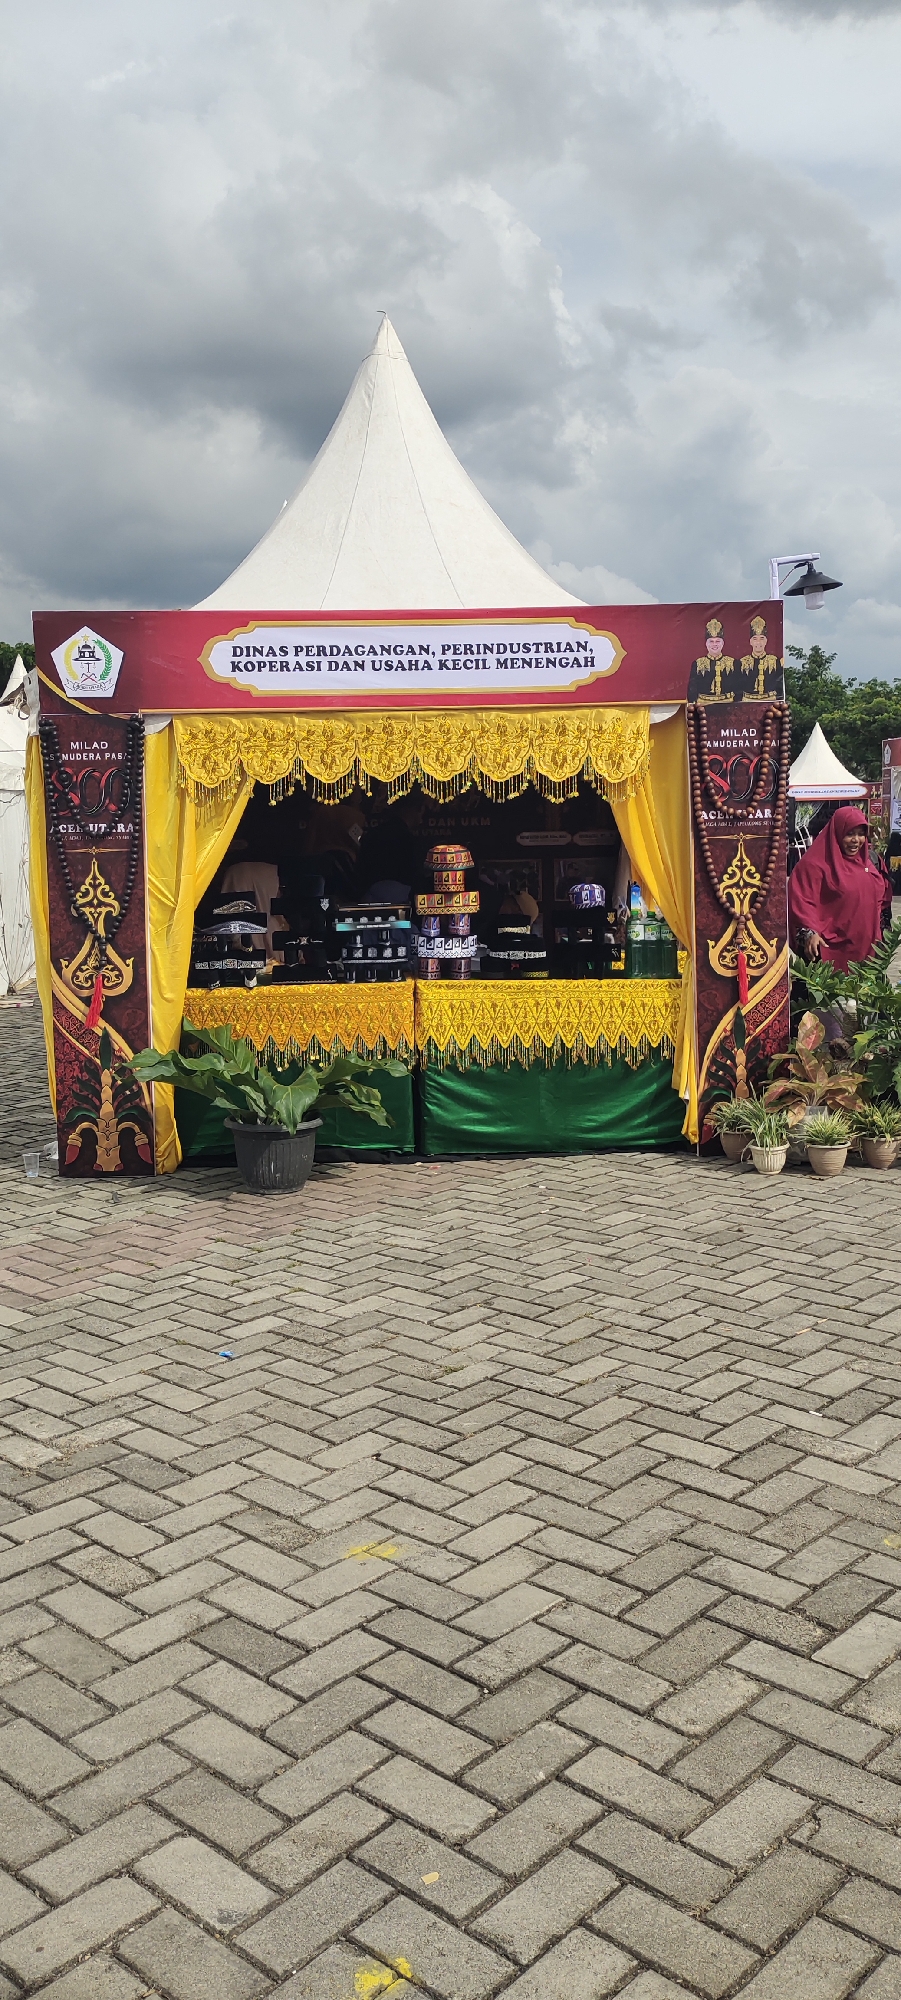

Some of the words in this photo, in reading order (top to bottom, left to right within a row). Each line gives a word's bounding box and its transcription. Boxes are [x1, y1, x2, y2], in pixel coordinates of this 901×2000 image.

[231, 645, 289, 658] DINAS
[293, 644, 436, 658] PERDAGANGAN,
[441, 641, 594, 656] PERINDUSTRIAN,
[230, 660, 322, 673] KOPERASI
[327, 660, 366, 672] DAN
[371, 659, 433, 672] USAHA
[438, 659, 491, 671] KECIL
[495, 656, 596, 670] MENENGAH
[720, 728, 757, 737] MILAD
[70, 741, 109, 750] MILAD
[706, 739, 750, 748] AMUDERA
[753, 739, 780, 747] PAAI
[49, 753, 102, 761] SMUDERA
[104, 753, 128, 761] PAS
[461, 817, 491, 826] UKM
[88, 822, 135, 833] UTRA
